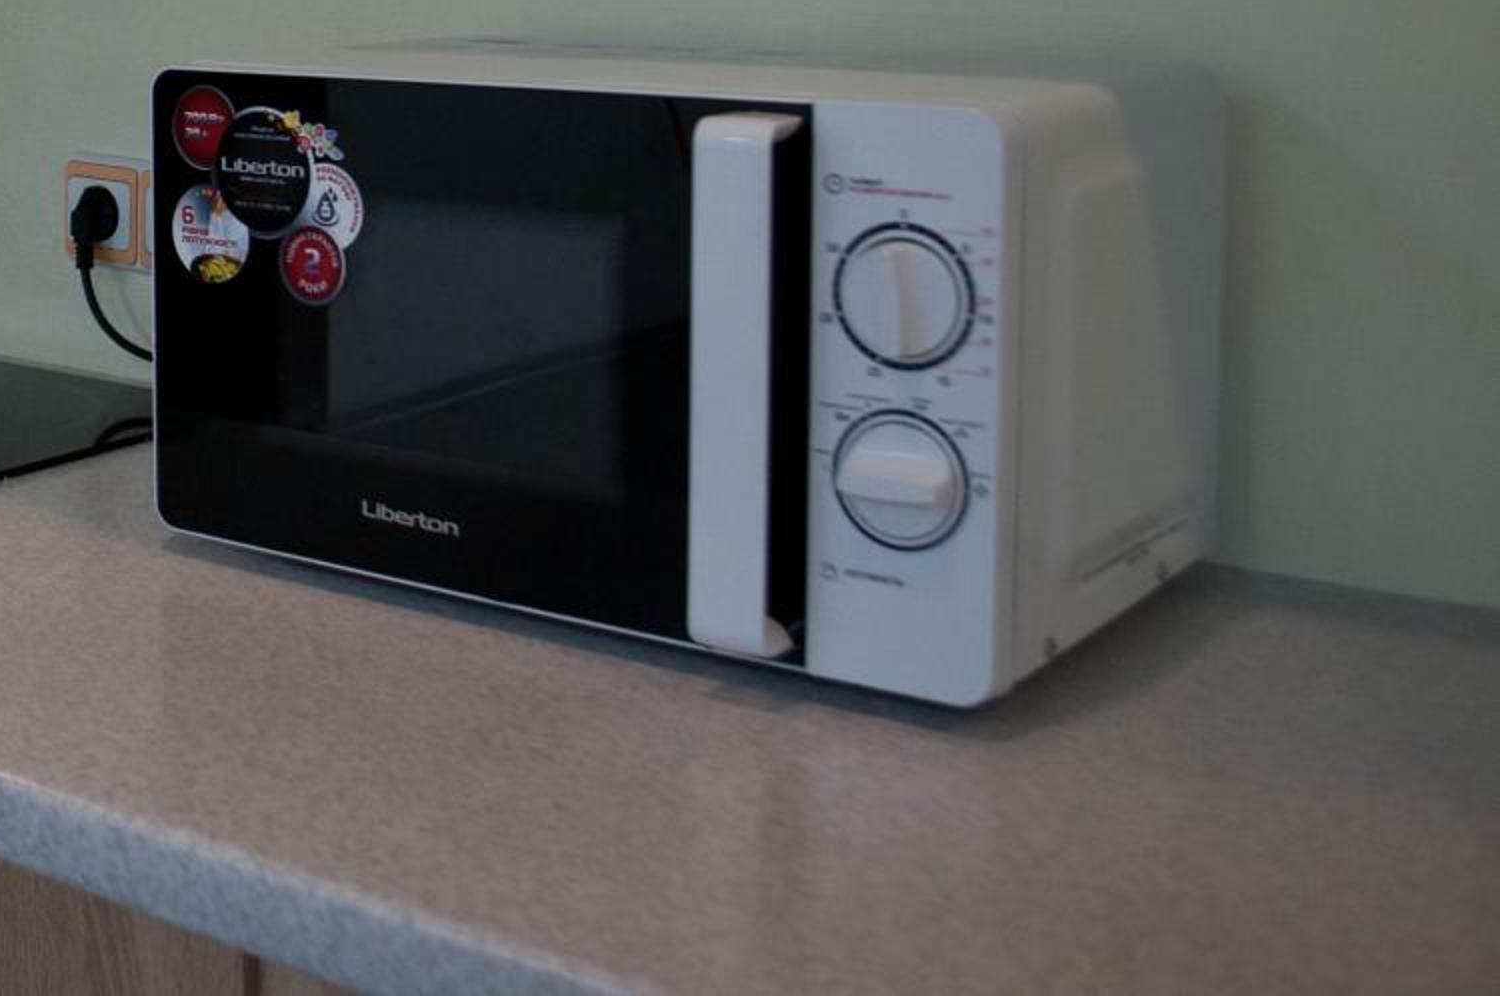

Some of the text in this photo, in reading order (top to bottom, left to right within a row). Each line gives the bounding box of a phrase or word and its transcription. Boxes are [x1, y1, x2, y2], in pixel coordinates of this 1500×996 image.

[221, 156, 305, 178] Liberton
[182, 206, 195, 224] 6
[361, 499, 460, 538] Liberton
